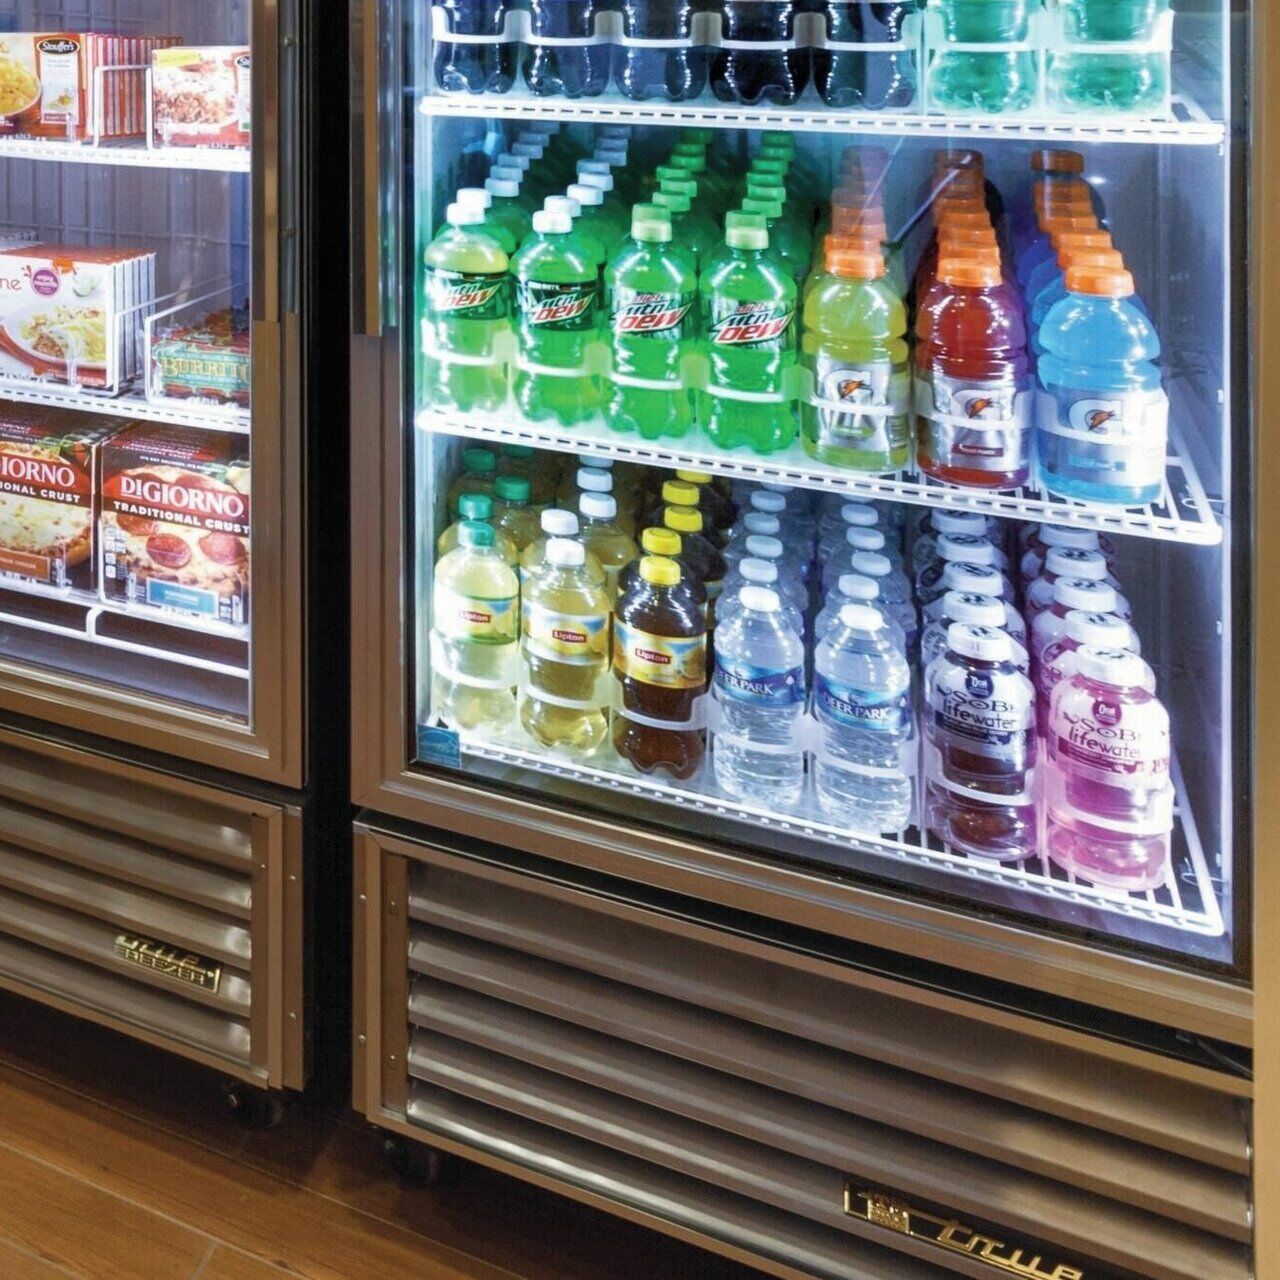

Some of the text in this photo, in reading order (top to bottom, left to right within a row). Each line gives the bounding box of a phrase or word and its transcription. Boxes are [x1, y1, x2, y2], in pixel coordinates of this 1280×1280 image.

[40, 41, 76, 53] Stouffer's
[40, 488, 81, 504] CRUST
[119, 475, 244, 518] DIGIORNO
[112, 500, 251, 536] TRADITIONAL CRUST
[460, 610, 491, 623] Lipton
[554, 631, 587, 642] Lipton
[636, 648, 670, 663] Lipton
[740, 679, 775, 696] PARK
[853, 705, 889, 720] PARK
[942, 699, 1016, 729] lifewater
